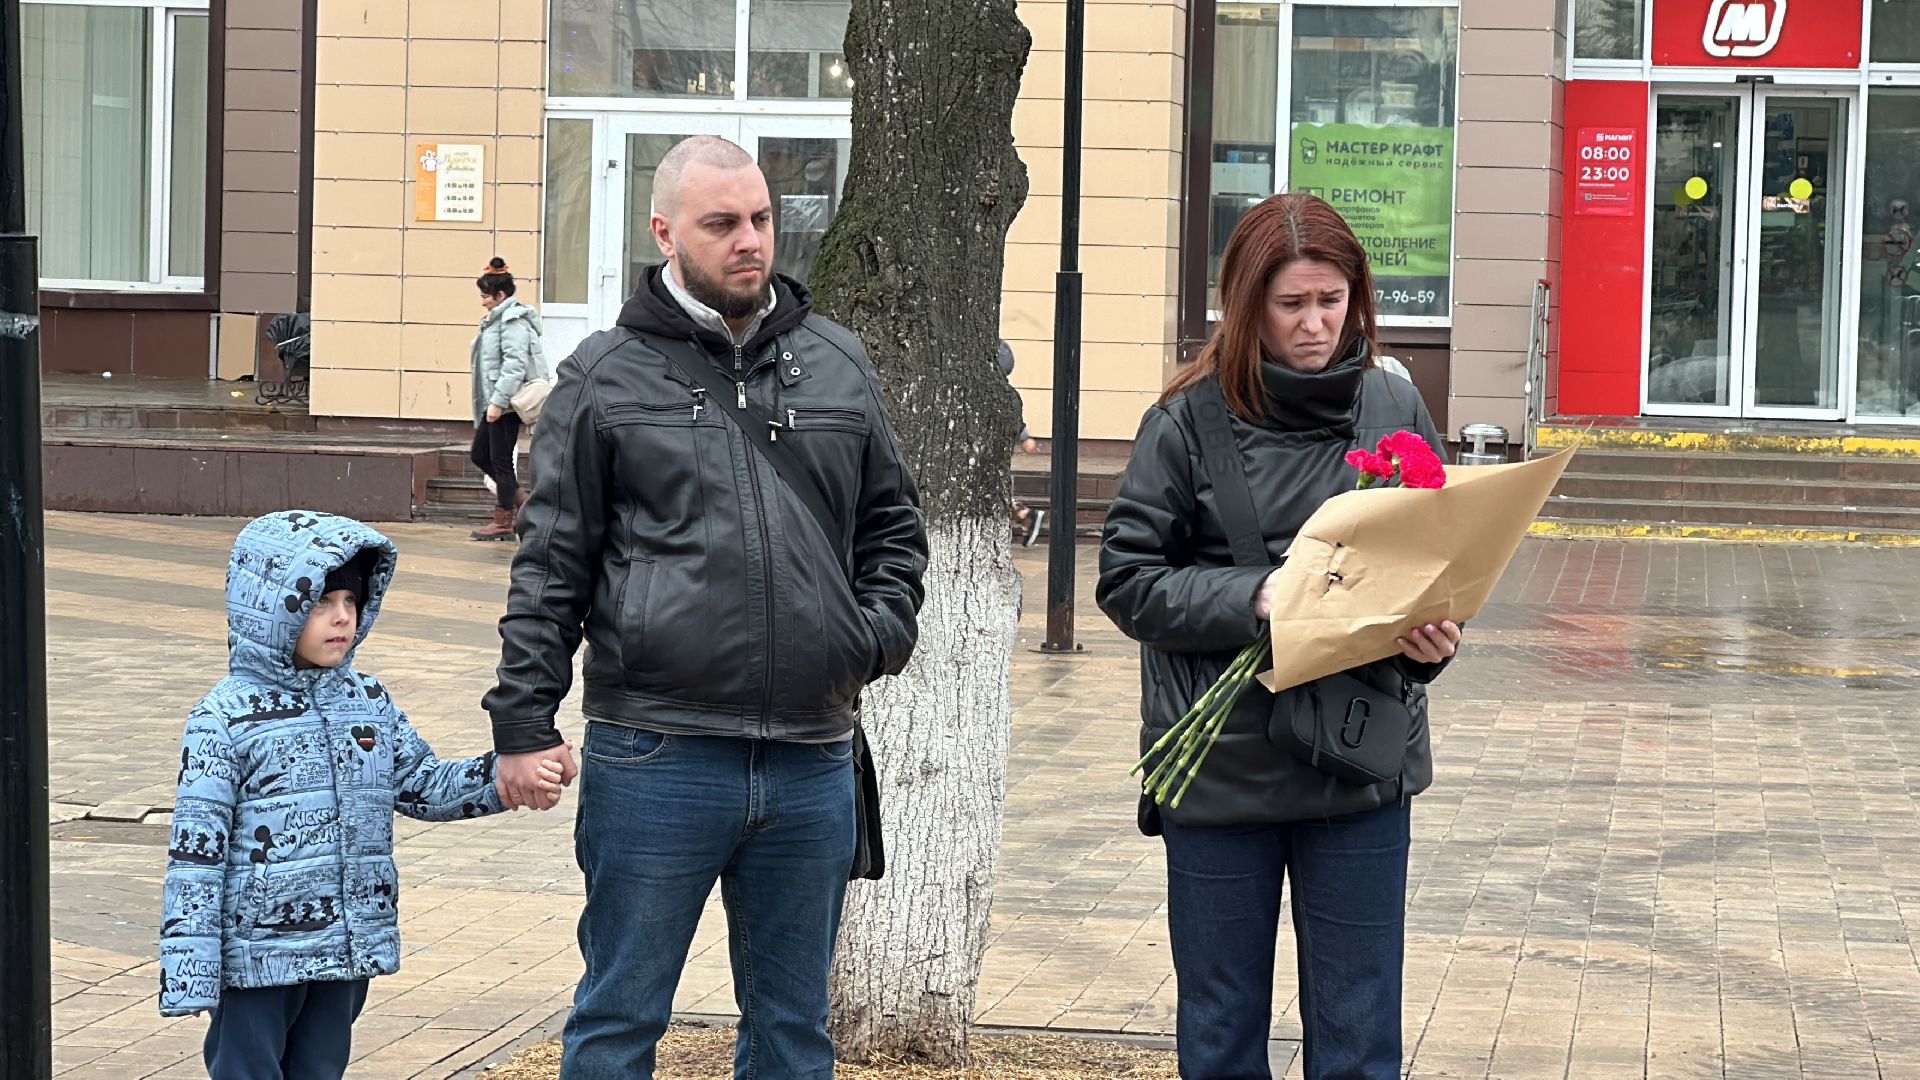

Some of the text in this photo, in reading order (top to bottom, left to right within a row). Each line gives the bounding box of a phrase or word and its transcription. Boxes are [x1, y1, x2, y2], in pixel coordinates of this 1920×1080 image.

[1326, 140, 1444, 157] МАСТЕР КРАФТ
[1581, 146, 1630, 160] 08:00
[1398, 159, 1444, 169] сервис
[1581, 166, 1630, 180] 23:00
[1331, 188, 1406, 204] РЕМОНТ
[1356, 236, 1436, 250] ОТОВЛЕНИЕ
[1367, 248, 1407, 267] ЧЕЙ
[1374, 289, 1436, 303] 7-96-59
[197, 738, 238, 761] MICK
[176, 957, 220, 979] MICKE
